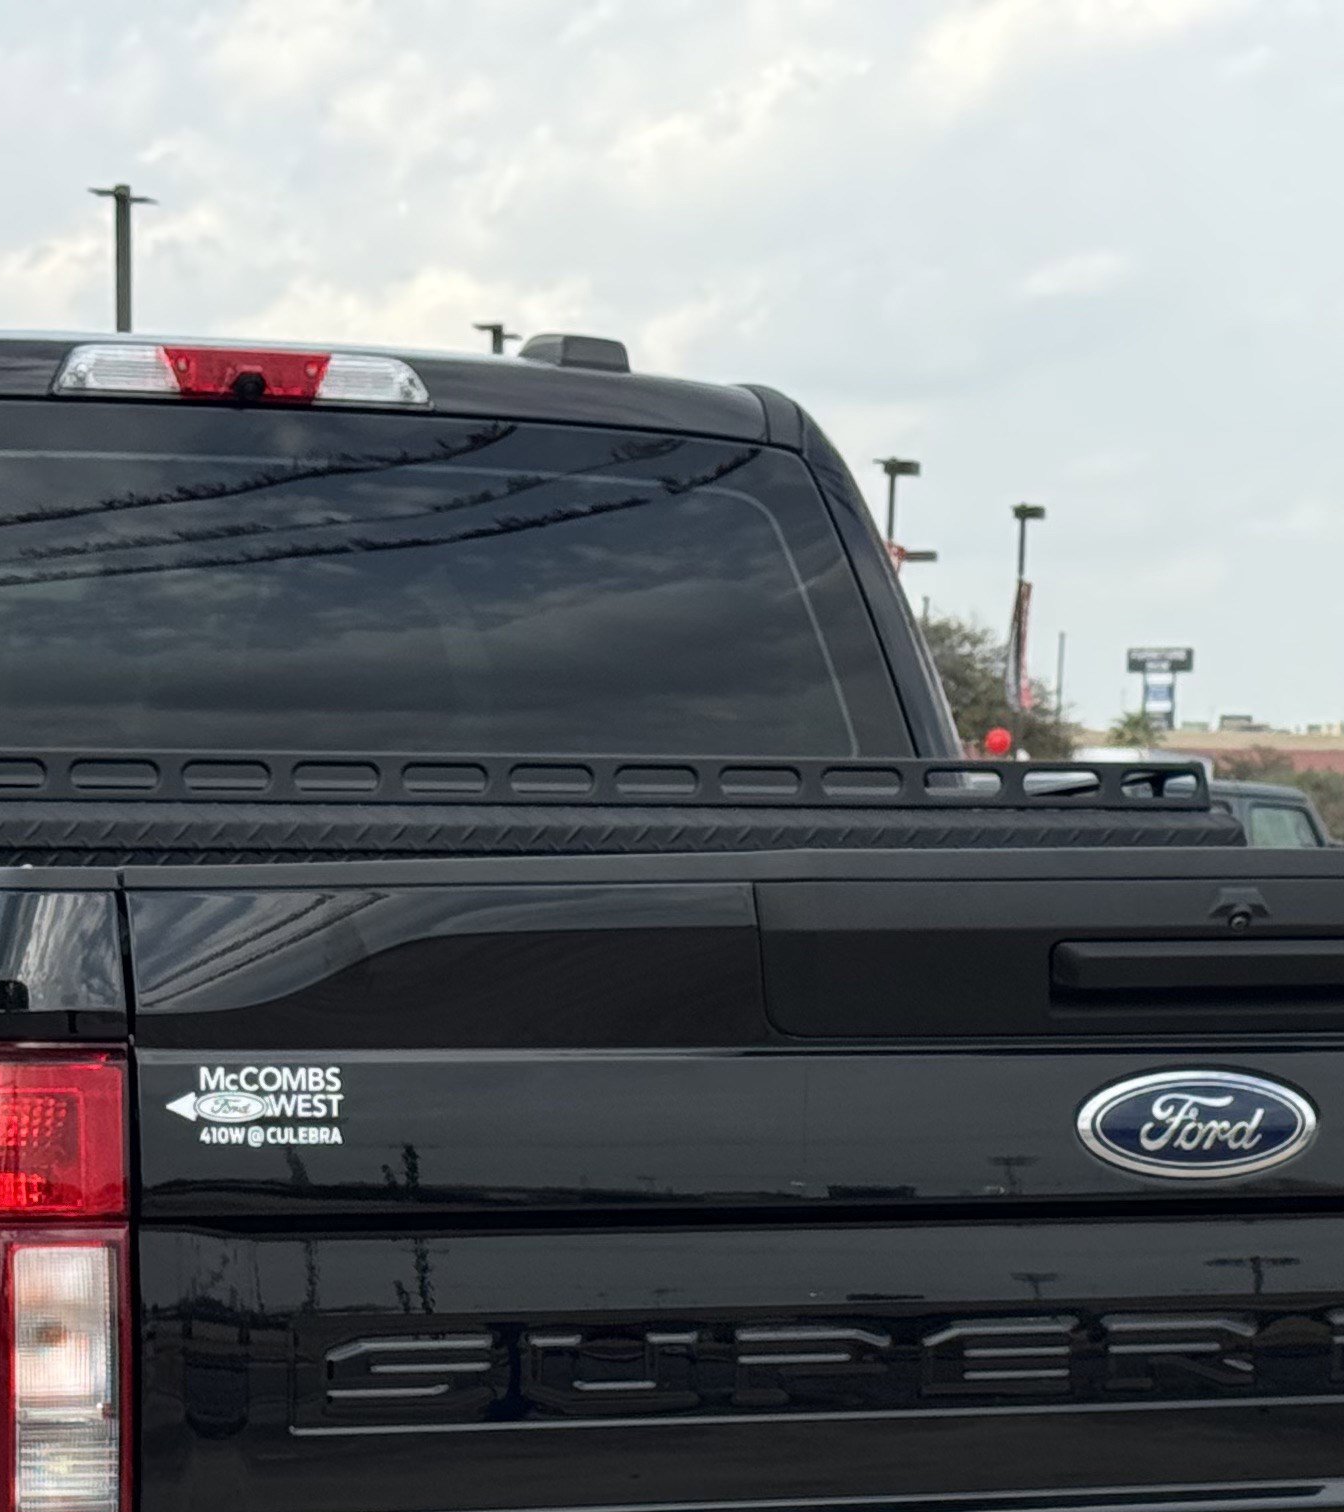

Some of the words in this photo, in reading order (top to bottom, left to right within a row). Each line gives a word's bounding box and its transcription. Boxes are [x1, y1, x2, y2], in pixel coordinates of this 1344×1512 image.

[199, 1066, 342, 1091] McCOMBS
[270, 1094, 344, 1117] WEST
[324, 1313, 1260, 1419] SUPER
